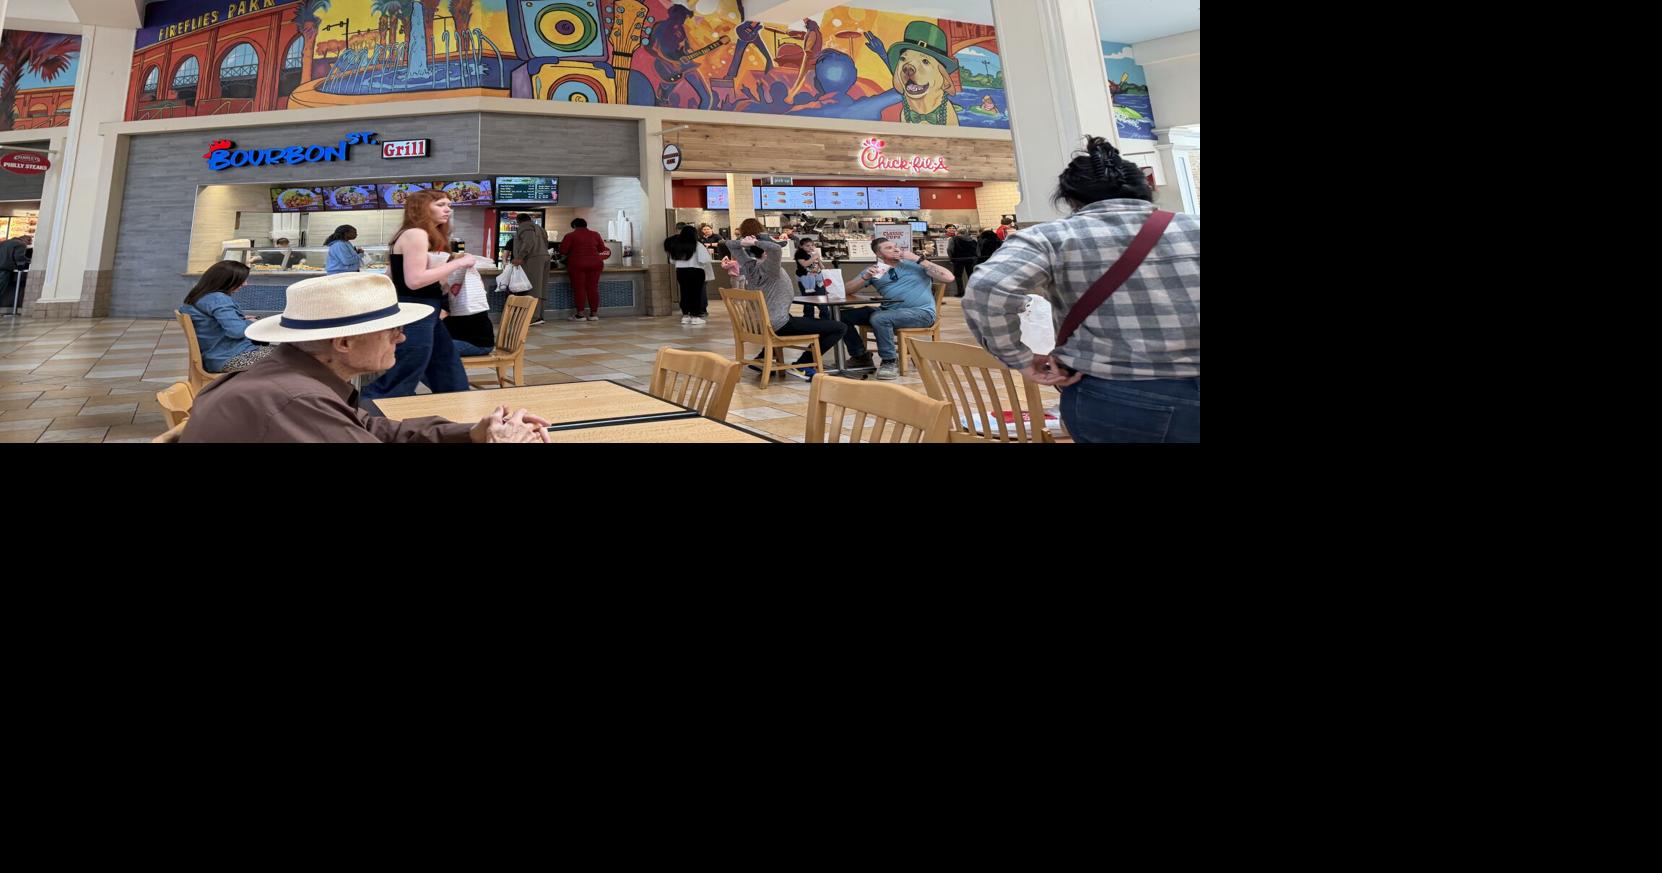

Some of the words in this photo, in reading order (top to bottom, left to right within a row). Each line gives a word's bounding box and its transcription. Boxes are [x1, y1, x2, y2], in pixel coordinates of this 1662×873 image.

[158, 10, 219, 41] FIREFLIES
[208, 141, 347, 170] BOURBON
[383, 140, 424, 157] Grill
